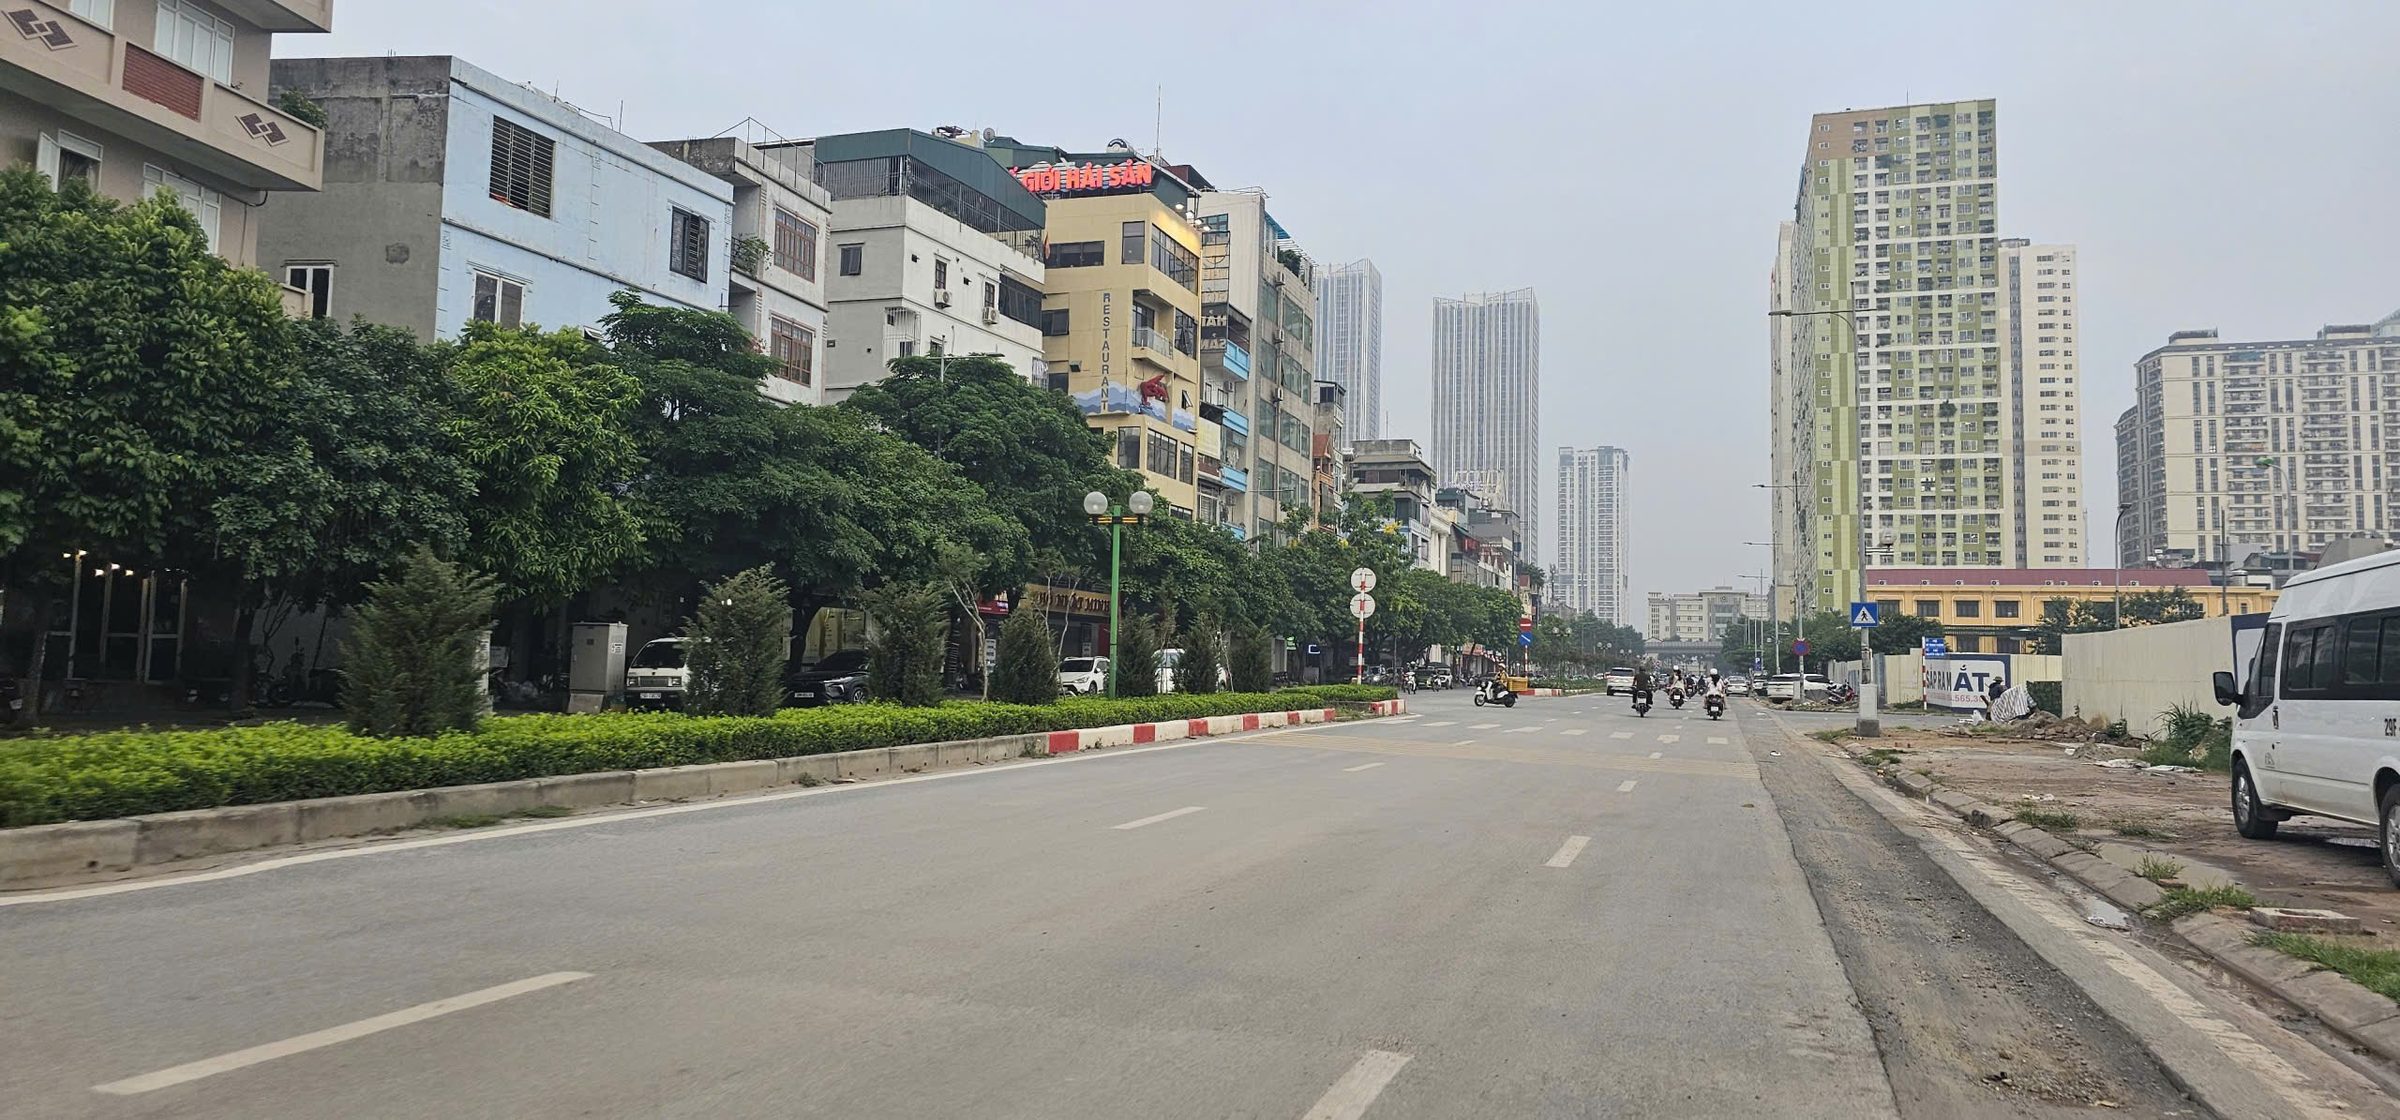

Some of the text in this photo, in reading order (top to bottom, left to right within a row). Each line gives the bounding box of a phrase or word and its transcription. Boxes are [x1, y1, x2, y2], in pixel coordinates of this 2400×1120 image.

[1066, 161, 1103, 189] HẢI
[1108, 158, 1152, 187] SẢN
[1100, 293, 1111, 411] RESTAURANT
